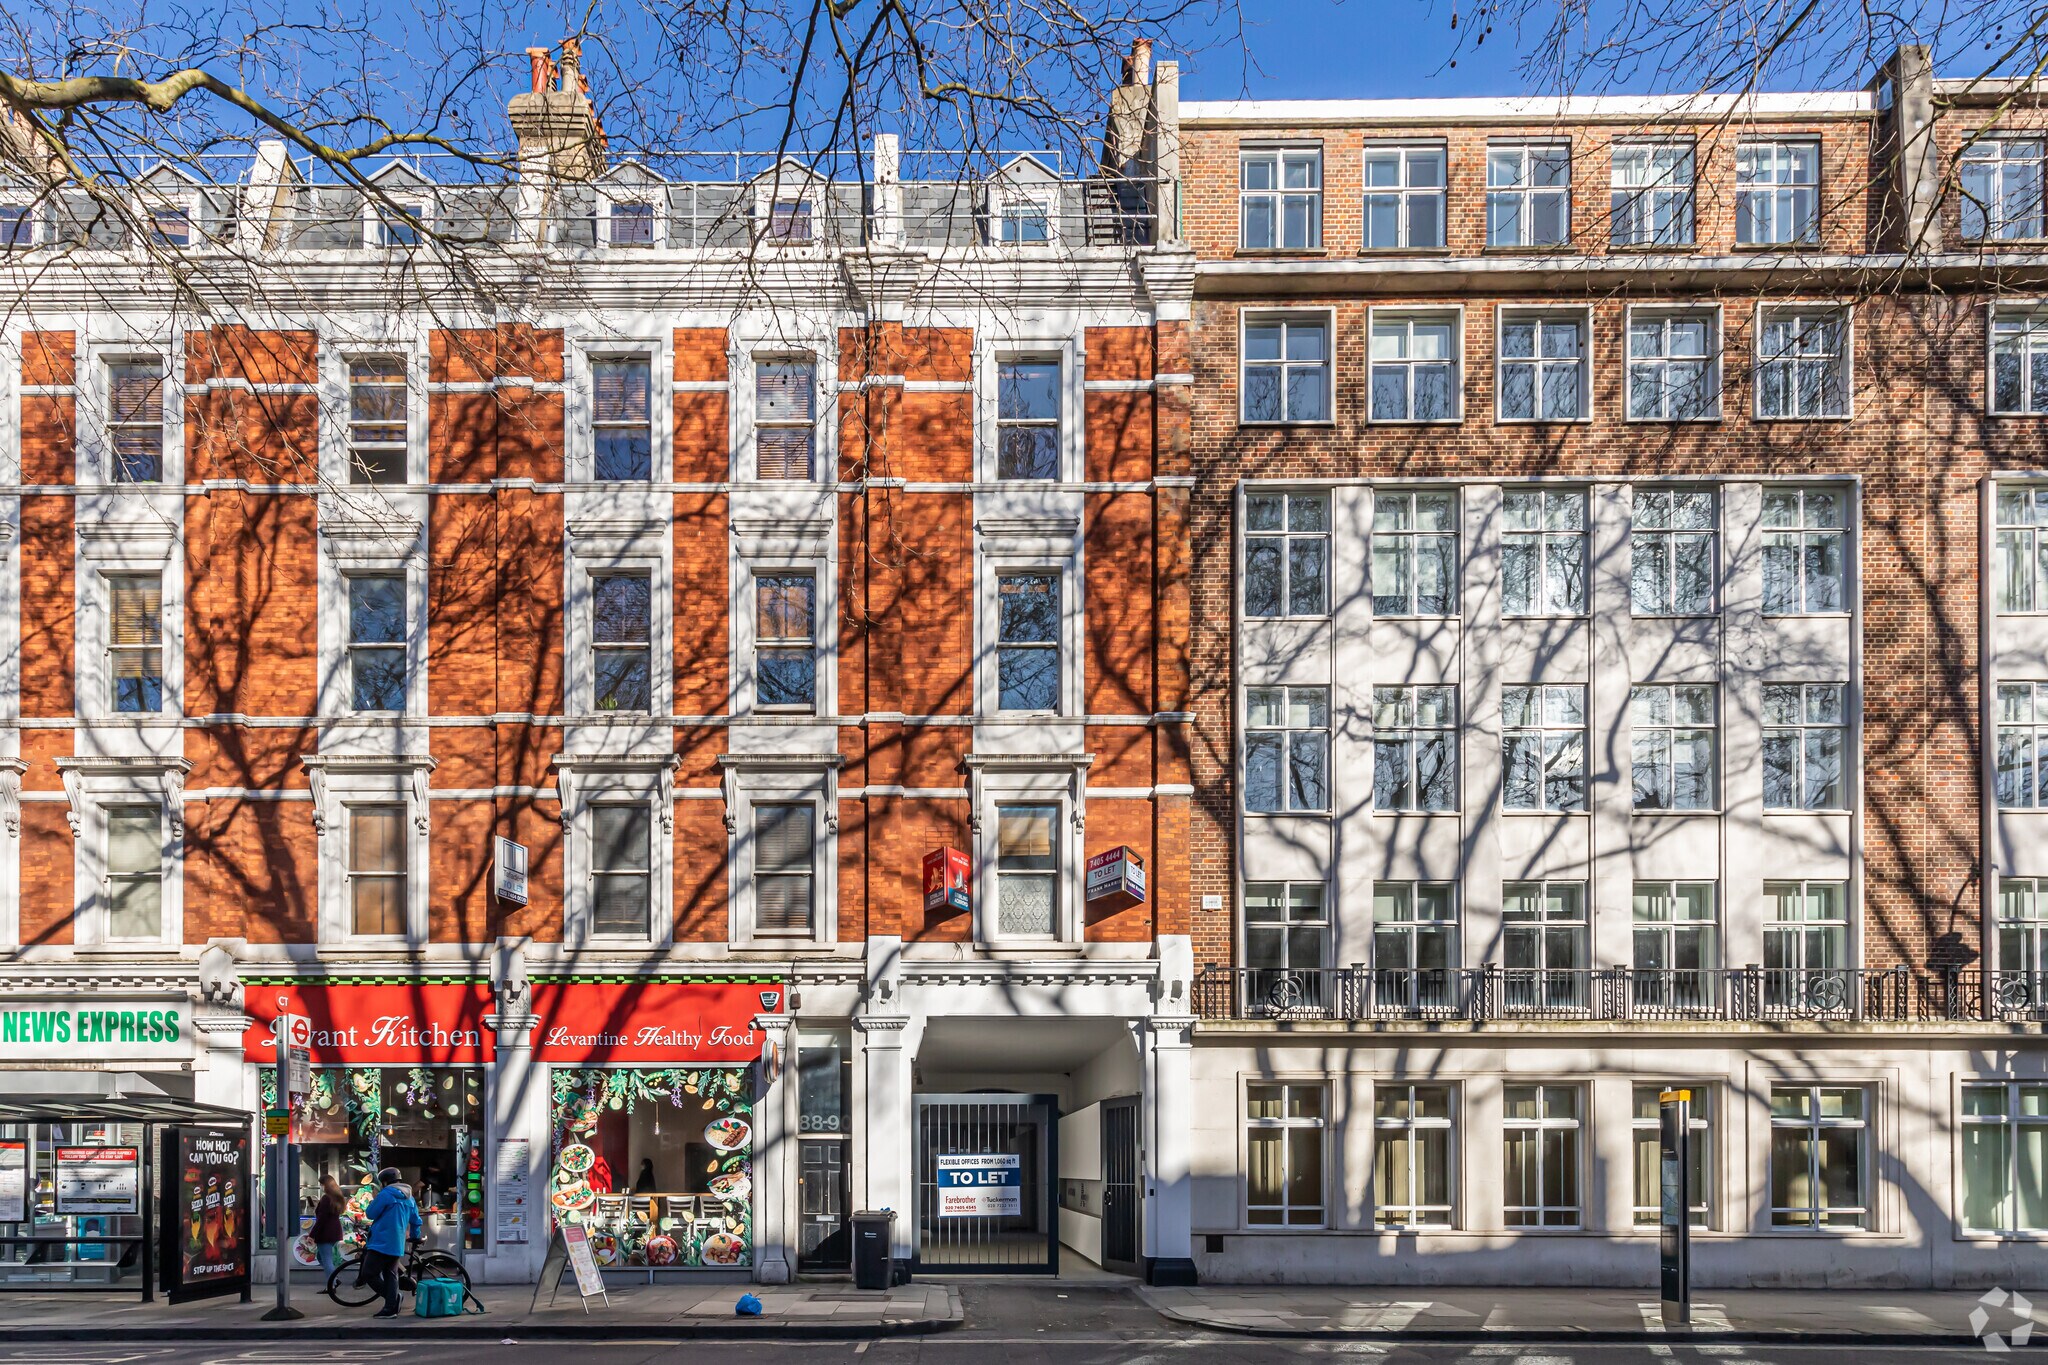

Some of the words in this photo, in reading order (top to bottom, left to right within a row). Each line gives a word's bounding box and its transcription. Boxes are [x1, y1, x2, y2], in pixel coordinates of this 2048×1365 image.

[1090, 857, 1104, 868] 7405
[1105, 850, 1120, 862] 4444
[1094, 870, 1102, 878] TO
[1104, 865, 1116, 875] LET
[503, 880, 512, 890] TO
[512, 883, 524, 893] LET
[278, 996, 288, 1006] CT
[3, 1010, 71, 1042] NEWS
[77, 1010, 180, 1042] EXPRESS
[364, 1016, 480, 1047] Kitchen
[544, 1026, 628, 1046] Levantine
[634, 1026, 702, 1050] Healthy
[708, 1026, 754, 1046] Food
[196, 1140, 214, 1152] HOW
[216, 1140, 231, 1152] HOT
[189, 1152, 204, 1164] CAN
[205, 1152, 222, 1164] YOU
[223, 1150, 239, 1165] GO?
[950, 1171, 973, 1184] TO
[978, 1171, 1008, 1184] LET
[945, 1196, 976, 1204] Farebrother
[194, 1265, 206, 1274] STEP
[221, 1262, 234, 1272] SPICE
